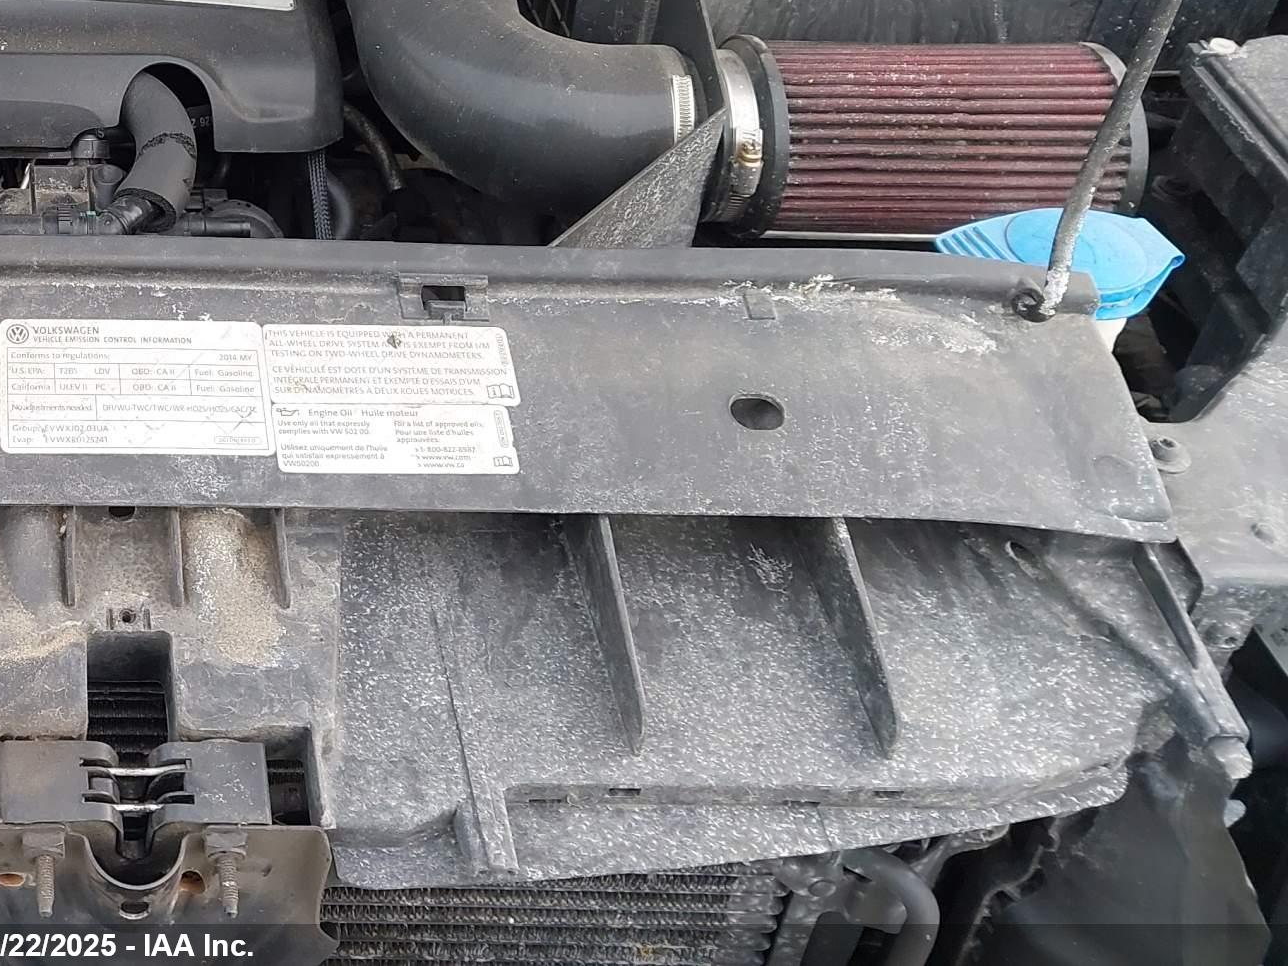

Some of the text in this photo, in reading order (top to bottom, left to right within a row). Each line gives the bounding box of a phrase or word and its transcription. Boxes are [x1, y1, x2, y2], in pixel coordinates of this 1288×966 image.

[32, 326, 100, 335] VOLKSWAGEN
[290, 330, 324, 338] VEHICLE
[327, 330, 335, 338] IS
[336, 330, 381, 340] EQUIPPED
[416, 331, 469, 339] PERMANENT
[319, 340, 345, 348] DRIVE
[414, 341, 446, 349] EXEMPT
[10, 352, 50, 360] Conforms
[52, 352, 60, 360] to
[308, 350, 322, 358] ON
[217, 369, 253, 377] Gasoline
[272, 366, 283, 374] CE
[328, 366, 342, 374] EST
[430, 367, 443, 375] DE
[444, 367, 508, 375] TRANSMISSION
[11, 383, 51, 391] California
[274, 386, 292, 394] SUR
[400, 387, 429, 395] ROUES
[308, 410, 338, 419] Engine
[292, 420, 308, 428] only
